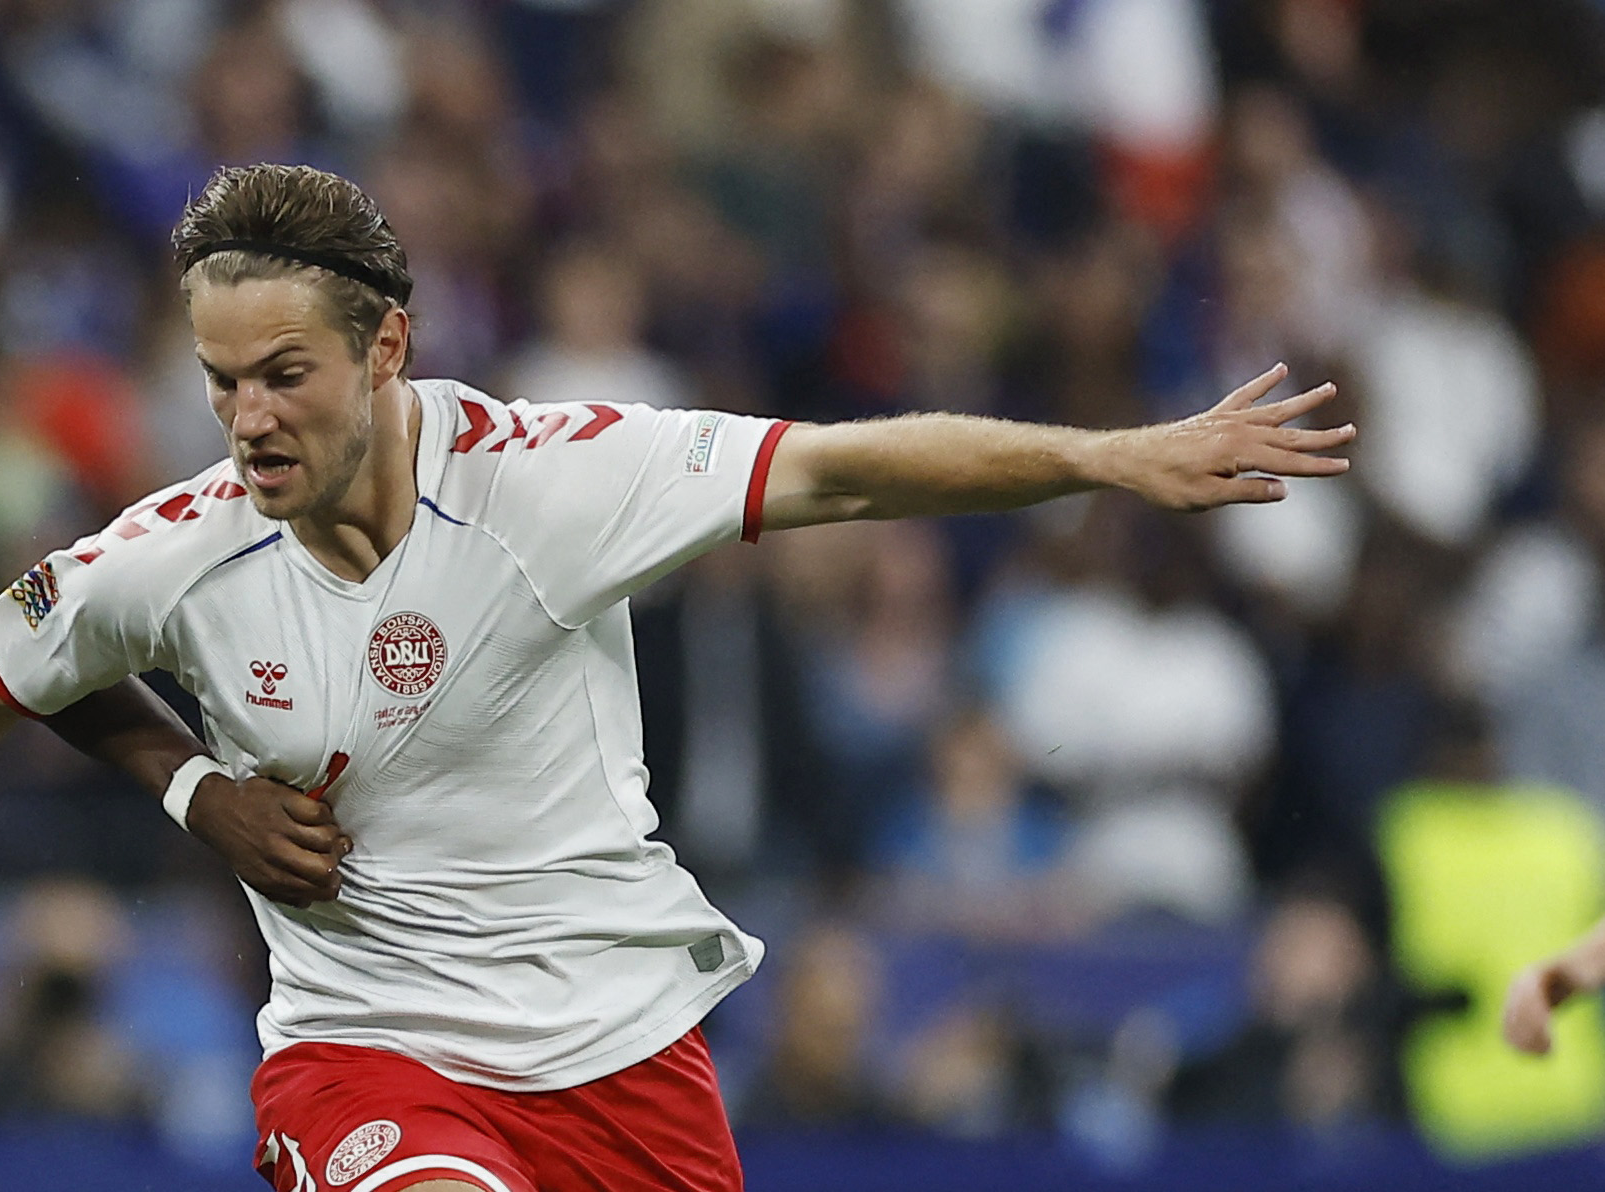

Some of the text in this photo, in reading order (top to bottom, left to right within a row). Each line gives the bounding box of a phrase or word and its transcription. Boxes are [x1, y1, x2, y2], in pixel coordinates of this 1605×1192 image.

[369, 640, 393, 686] DANSK
[383, 640, 431, 667] DBU
[245, 690, 293, 711] hummel
[395, 681, 428, 695] 1889
[340, 1134, 384, 1170] DBU
